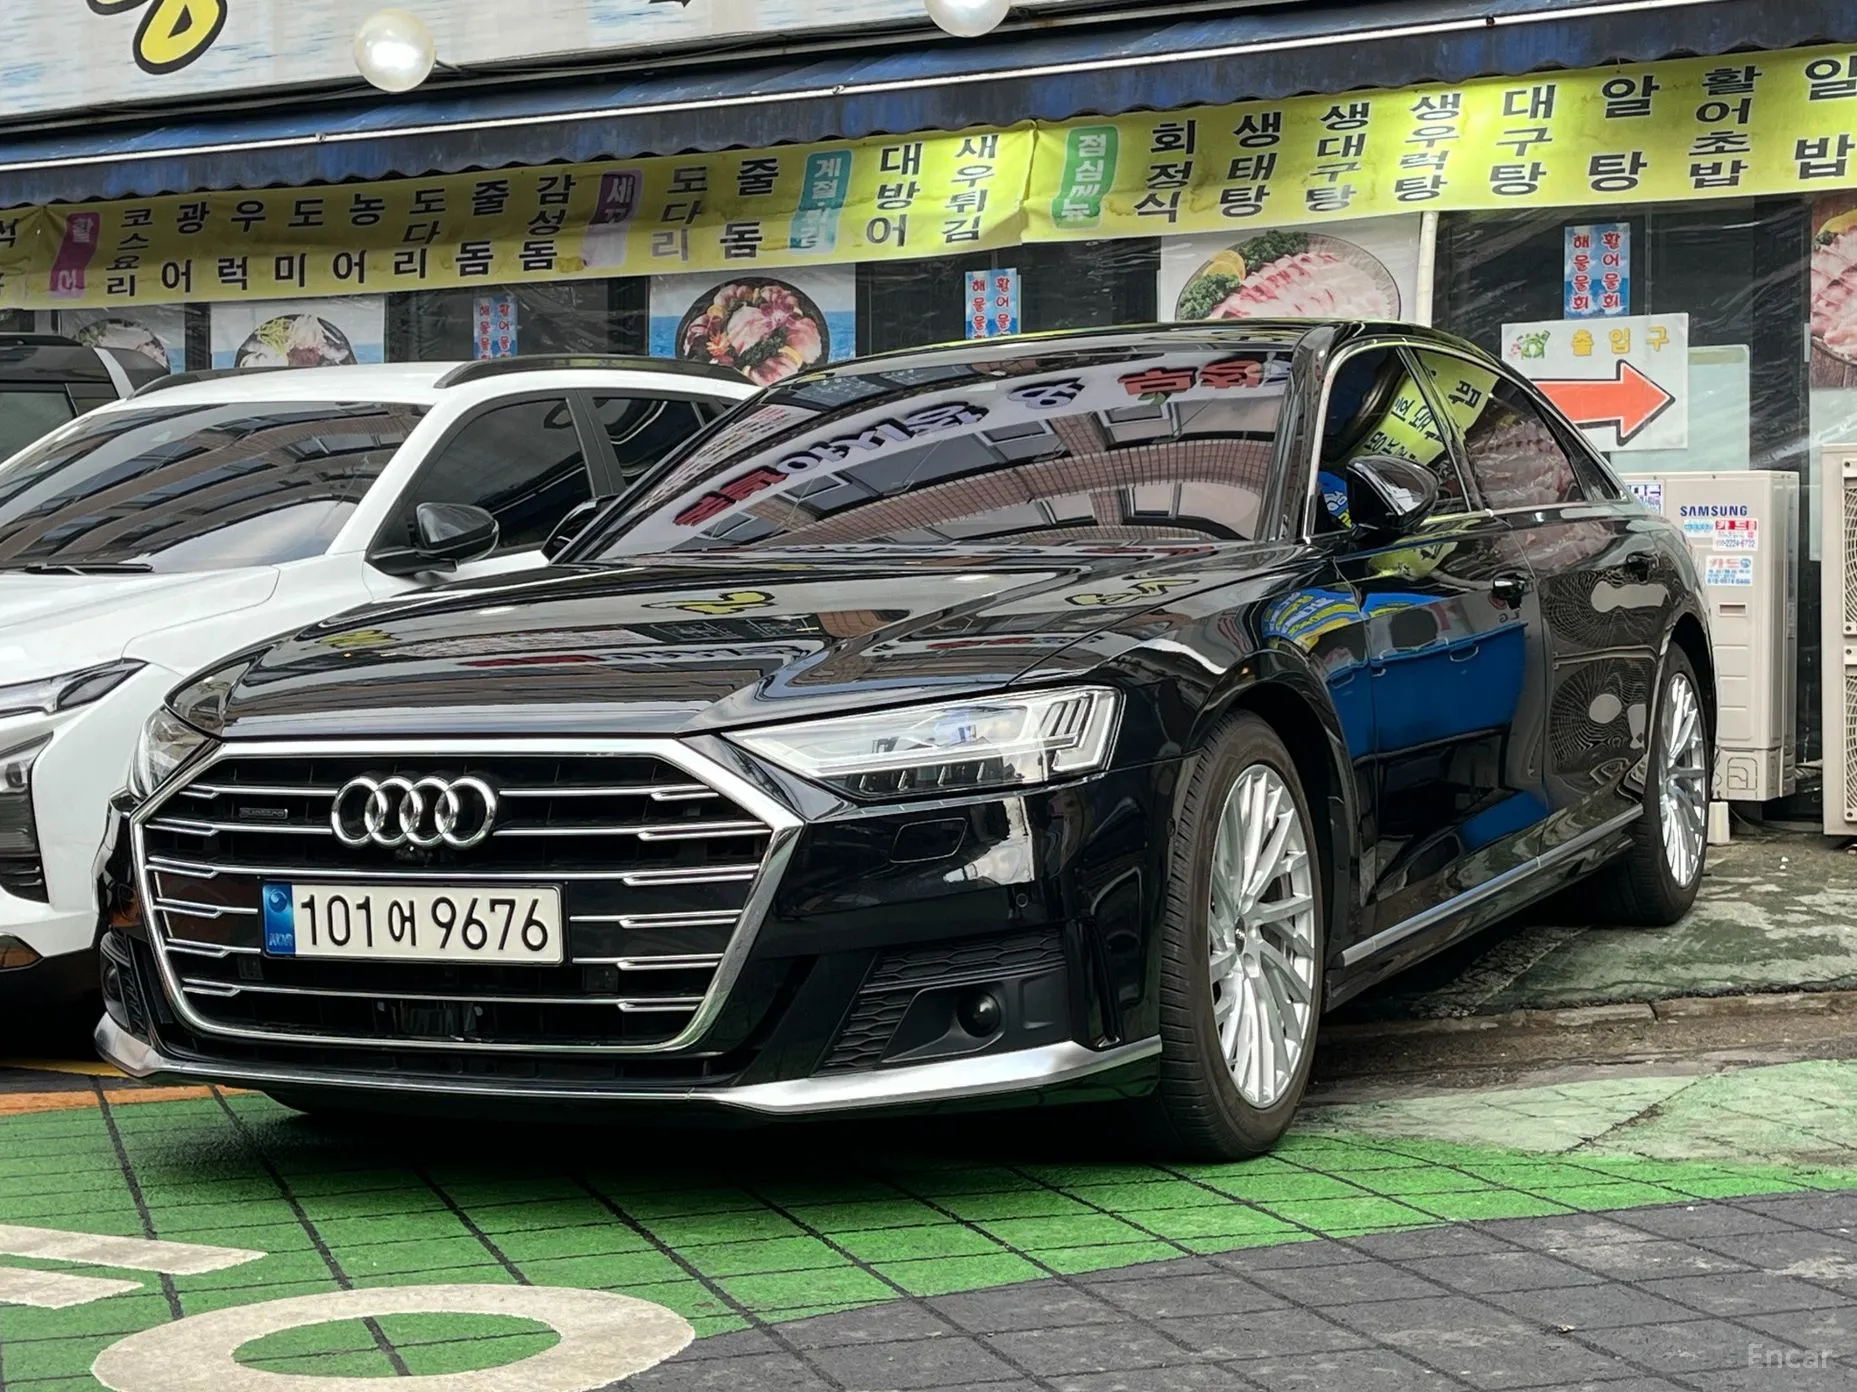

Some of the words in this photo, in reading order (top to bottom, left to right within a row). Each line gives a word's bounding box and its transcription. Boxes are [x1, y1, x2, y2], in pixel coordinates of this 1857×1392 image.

[1134, 120, 1197, 223] 회정식
[1220, 112, 1282, 217] 생태탕
[1306, 102, 1370, 212] 생대구탕
[1394, 93, 1462, 202] 생우럭탕
[1489, 84, 1556, 195] 대구탕
[1588, 76, 1660, 192] 알탕
[1689, 66, 1762, 190] 활어초밥
[518, 174, 577, 271] 감성돔
[652, 166, 708, 262] 도다리
[720, 158, 780, 258] 줄돔
[866, 143, 922, 248] 대방어
[941, 135, 1000, 243] 새우튀김
[1061, 133, 1108, 223] 점심메뉴
[106, 208, 153, 297] 코스요리
[161, 201, 210, 293] 광어
[218, 204, 266, 290] 우럭
[274, 198, 325, 287] 도미
[333, 193, 386, 283] 농어
[393, 188, 446, 279] 도다리
[455, 180, 510, 276] 줄돔
[1680, 505, 1748, 517] SAMSUNG
[301, 894, 417, 948] 101어
[431, 897, 548, 951] 9676
